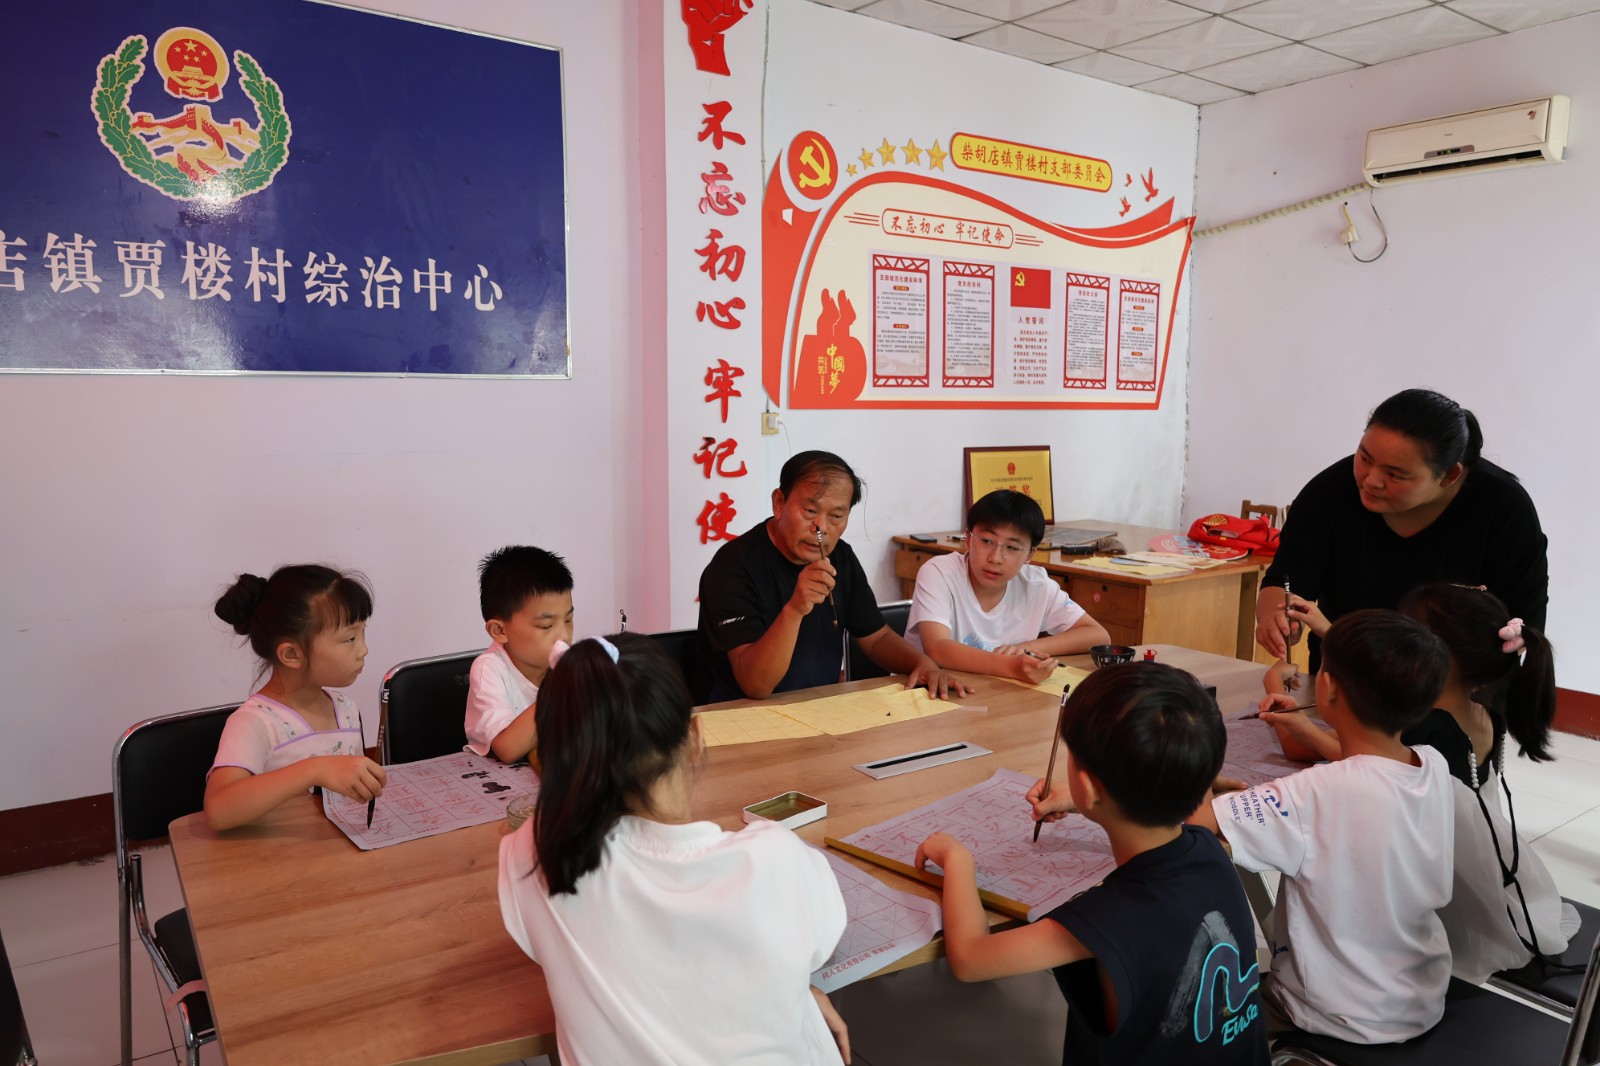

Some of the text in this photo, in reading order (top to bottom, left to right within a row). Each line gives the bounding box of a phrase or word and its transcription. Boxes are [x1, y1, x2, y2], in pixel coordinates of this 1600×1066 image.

[961, 142, 1106, 184] 柴胡店镇贾楼村支部委员会
[890, 215, 1005, 246] 不忘初心 牢记使命
